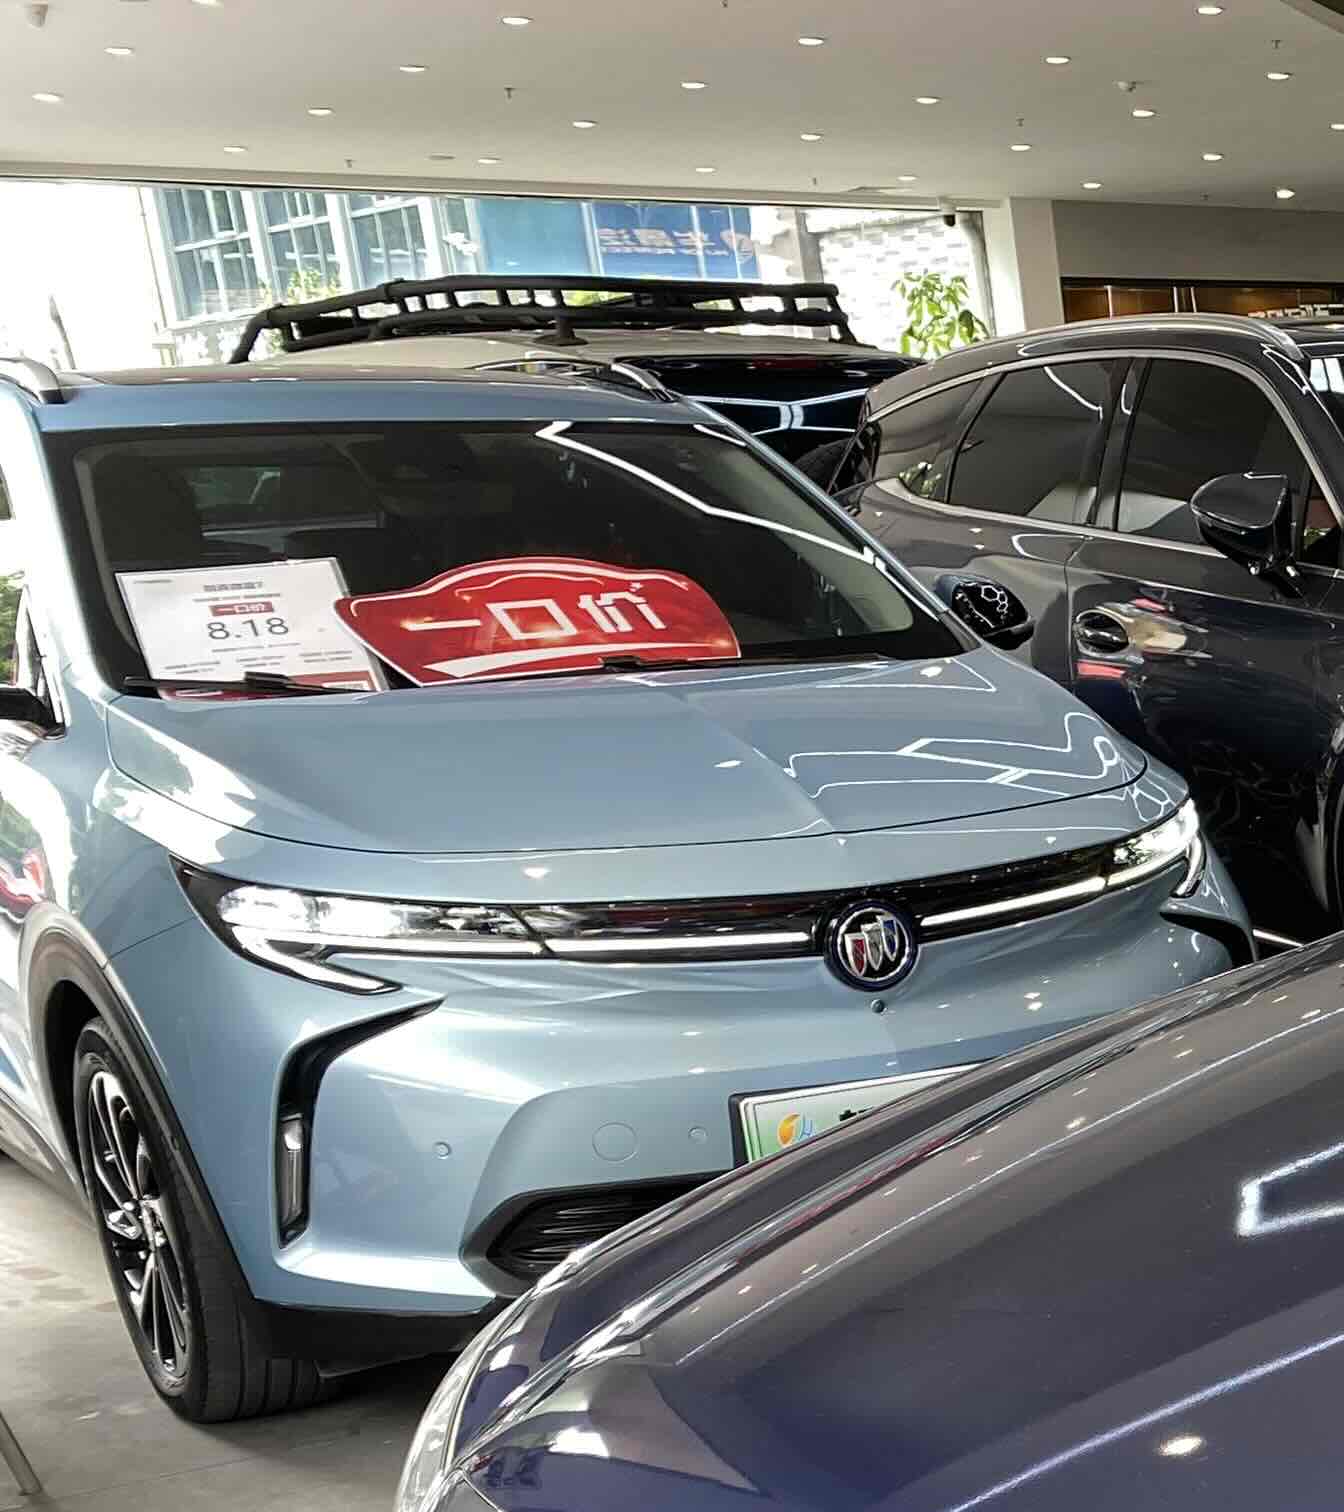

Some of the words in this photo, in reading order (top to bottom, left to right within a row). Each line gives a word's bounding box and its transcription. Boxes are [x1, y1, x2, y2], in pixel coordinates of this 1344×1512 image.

[207, 617, 289, 640] 8.18
[401, 583, 667, 641] 一口价
